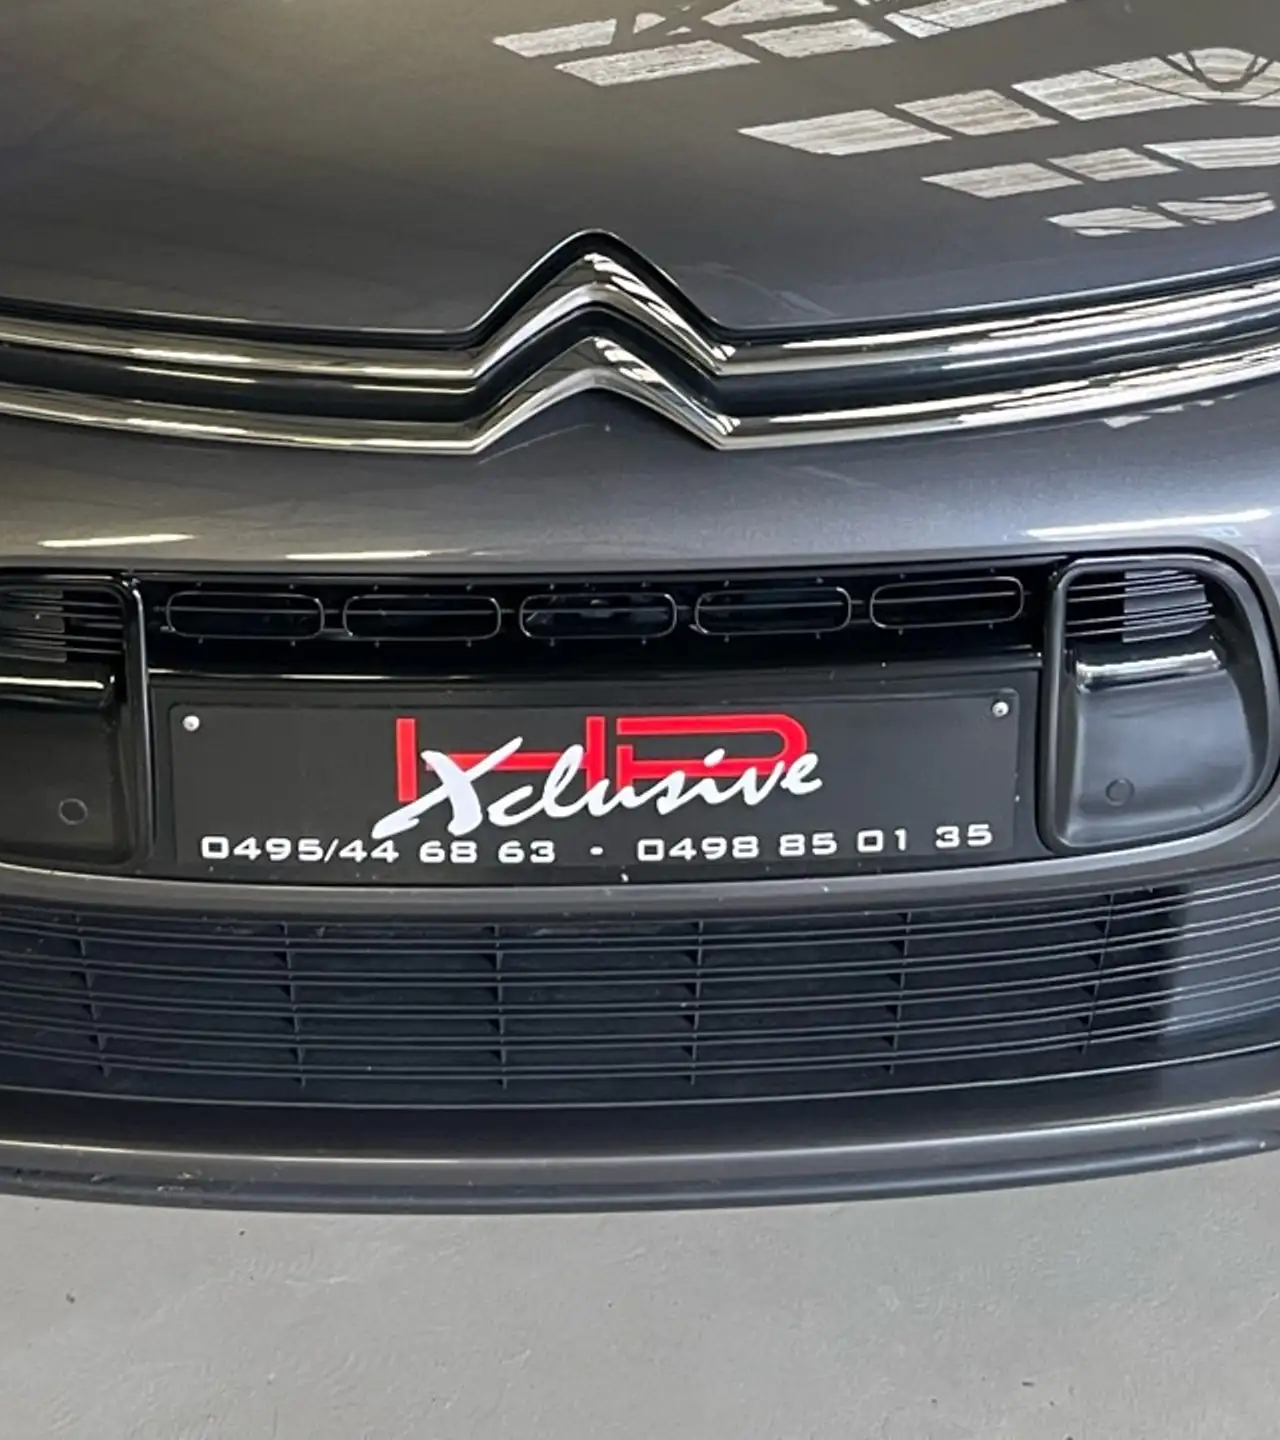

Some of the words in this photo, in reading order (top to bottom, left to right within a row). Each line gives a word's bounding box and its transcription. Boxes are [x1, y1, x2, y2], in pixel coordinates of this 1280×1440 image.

[200, 836, 399, 863] 0495/44
[419, 840, 477, 863] 68
[498, 840, 556, 864] 63
[637, 835, 758, 862] 0498
[779, 831, 837, 857] 85
[857, 828, 908, 852] 01
[935, 823, 993, 848] 35
